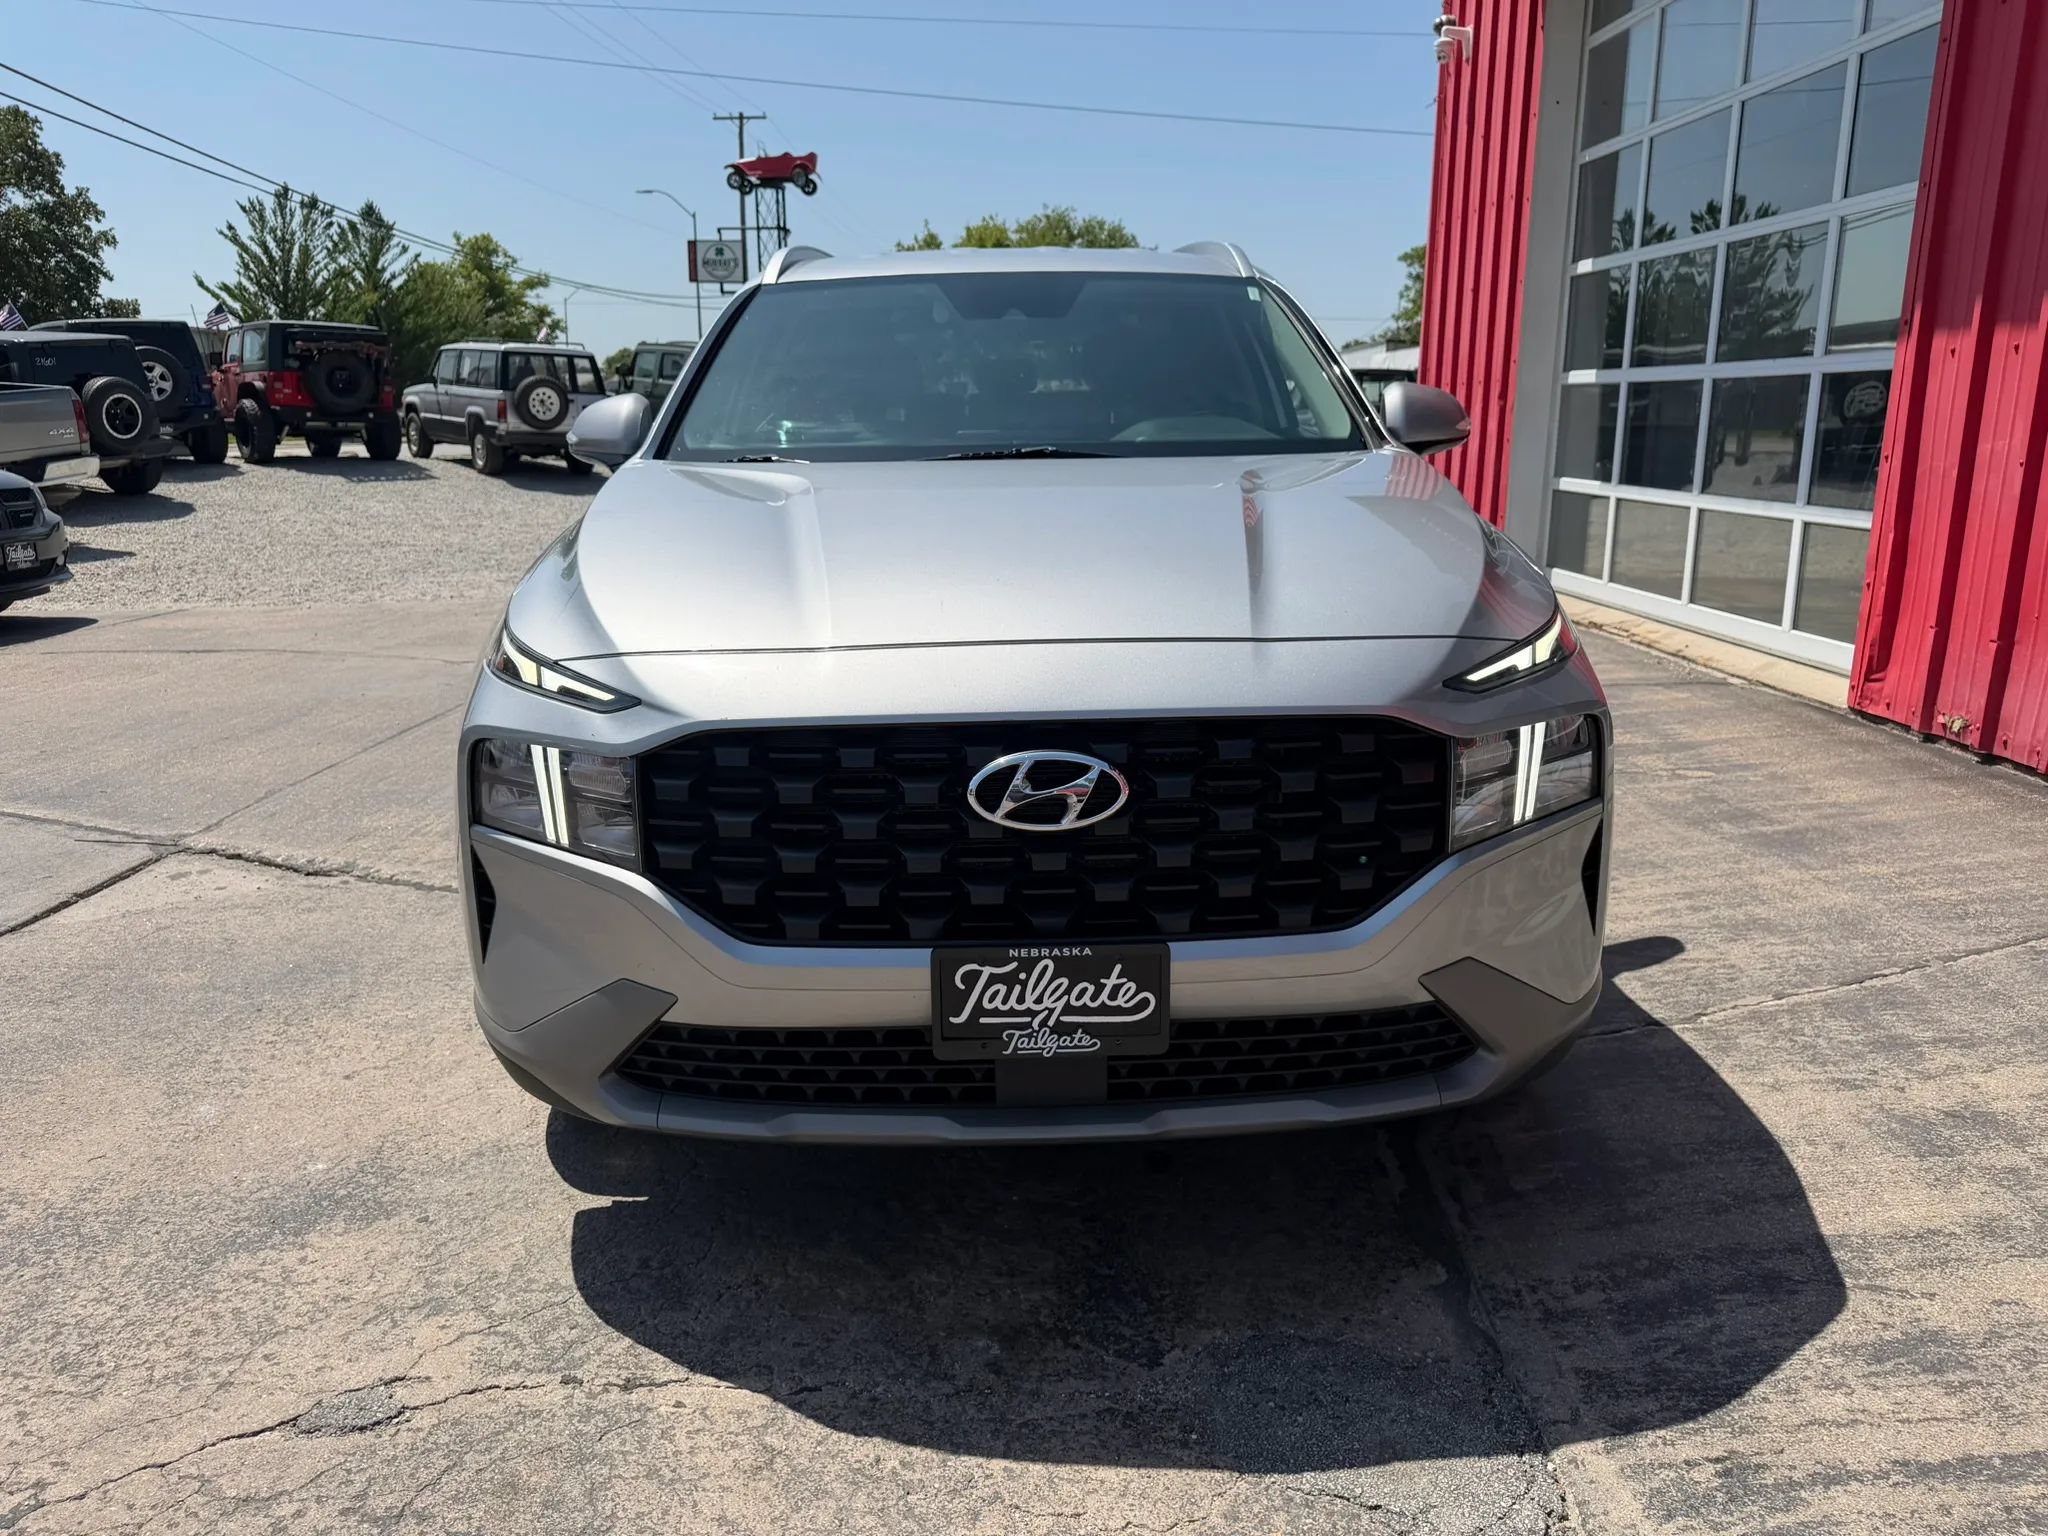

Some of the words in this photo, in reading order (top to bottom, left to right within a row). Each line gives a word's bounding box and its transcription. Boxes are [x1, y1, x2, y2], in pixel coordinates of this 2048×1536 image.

[1009, 947, 1093, 958] NEBRASKA
[948, 958, 1156, 1030] Tailgate
[1002, 1027, 1101, 1057] Tailgate
